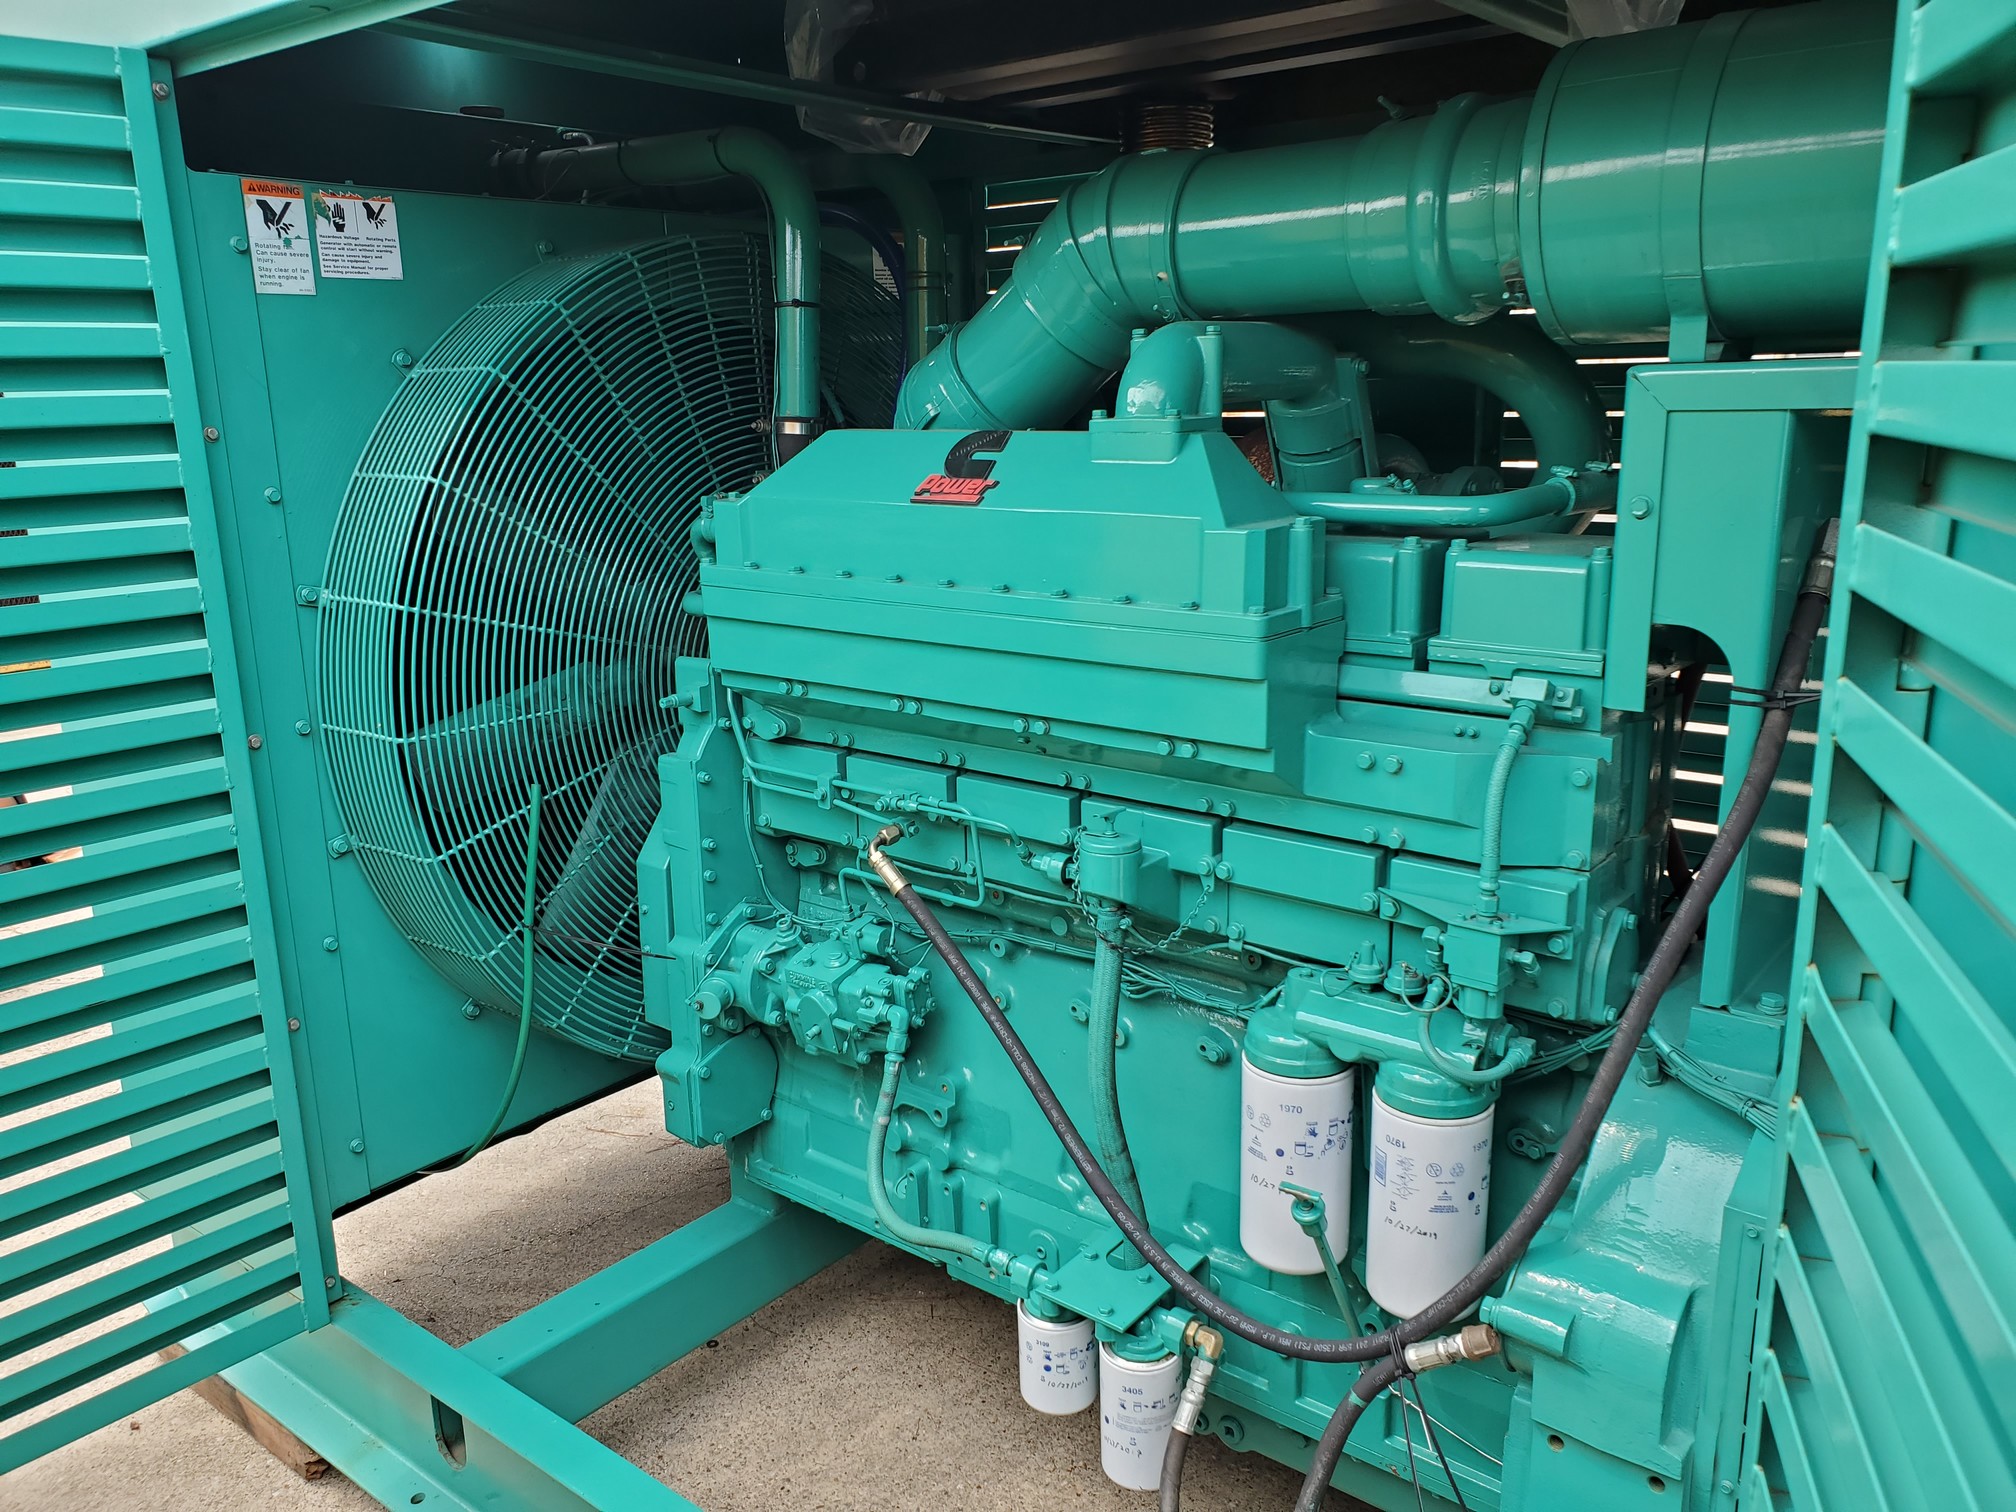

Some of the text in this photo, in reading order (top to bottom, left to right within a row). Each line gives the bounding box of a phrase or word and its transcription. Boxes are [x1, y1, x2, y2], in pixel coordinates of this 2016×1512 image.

[256, 184, 300, 195] WARNING
[1279, 1104, 1303, 1114] 1970
[1385, 1134, 1406, 1149] 1970
[1063, 1131, 1093, 1174] WEATHERHEAD
[1250, 1173, 1278, 1191] 10/27
[1159, 1260, 1170, 1271] IN
[1168, 1269, 1185, 1285] MADE
[1121, 1385, 1144, 1396] 3405
